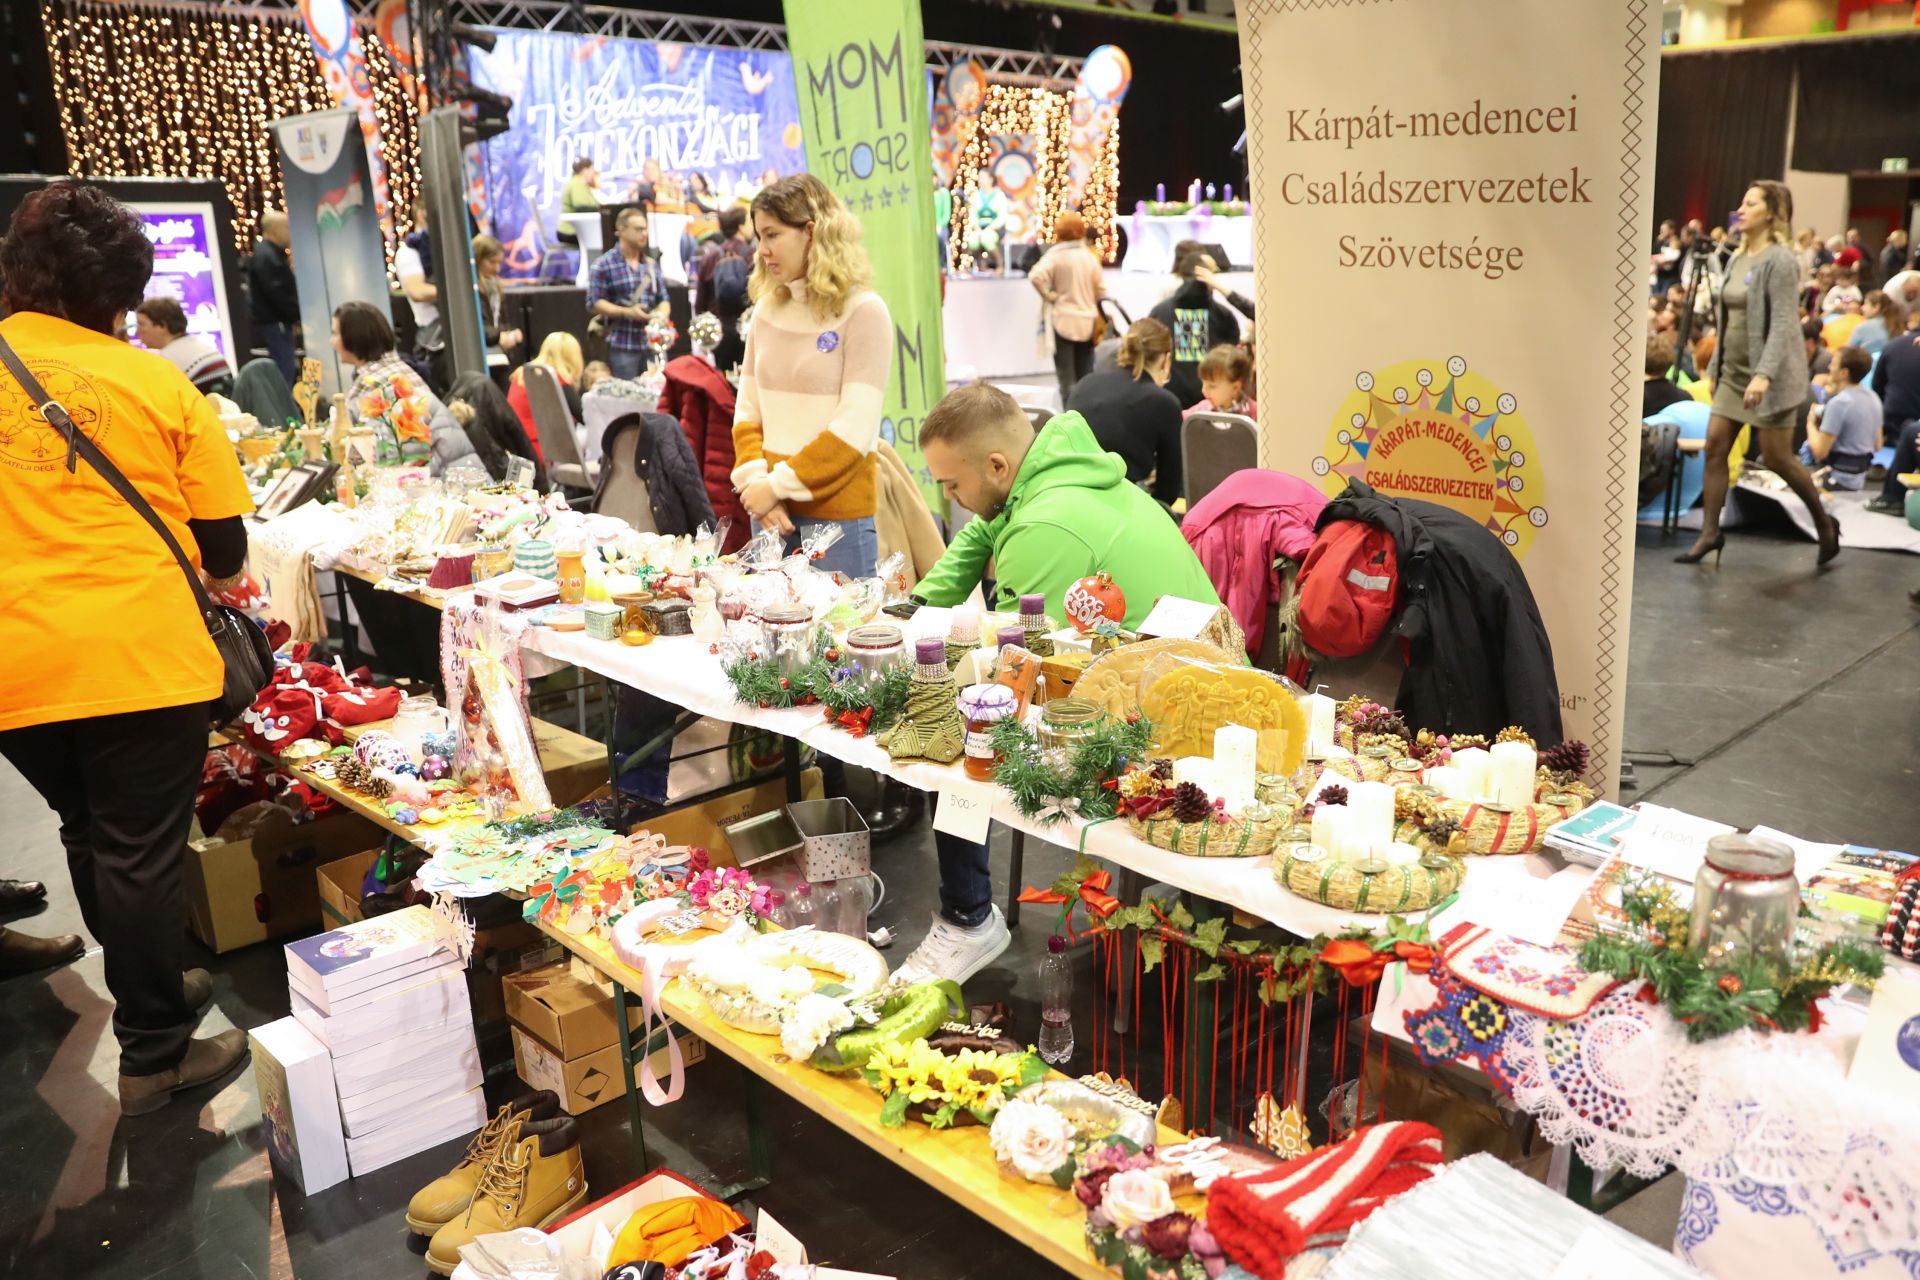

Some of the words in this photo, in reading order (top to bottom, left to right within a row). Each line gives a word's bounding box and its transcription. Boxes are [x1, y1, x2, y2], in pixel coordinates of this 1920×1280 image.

[1286, 94, 1578, 149] Kárpát-medencei
[1281, 166, 1593, 206] Családszervezetek
[1338, 235, 1524, 281] Szövetsége
[1374, 418, 1489, 474] KÁRPÁT-MEDENCEI
[1366, 470, 1495, 502] CSALÁDSZERVEZETEK
